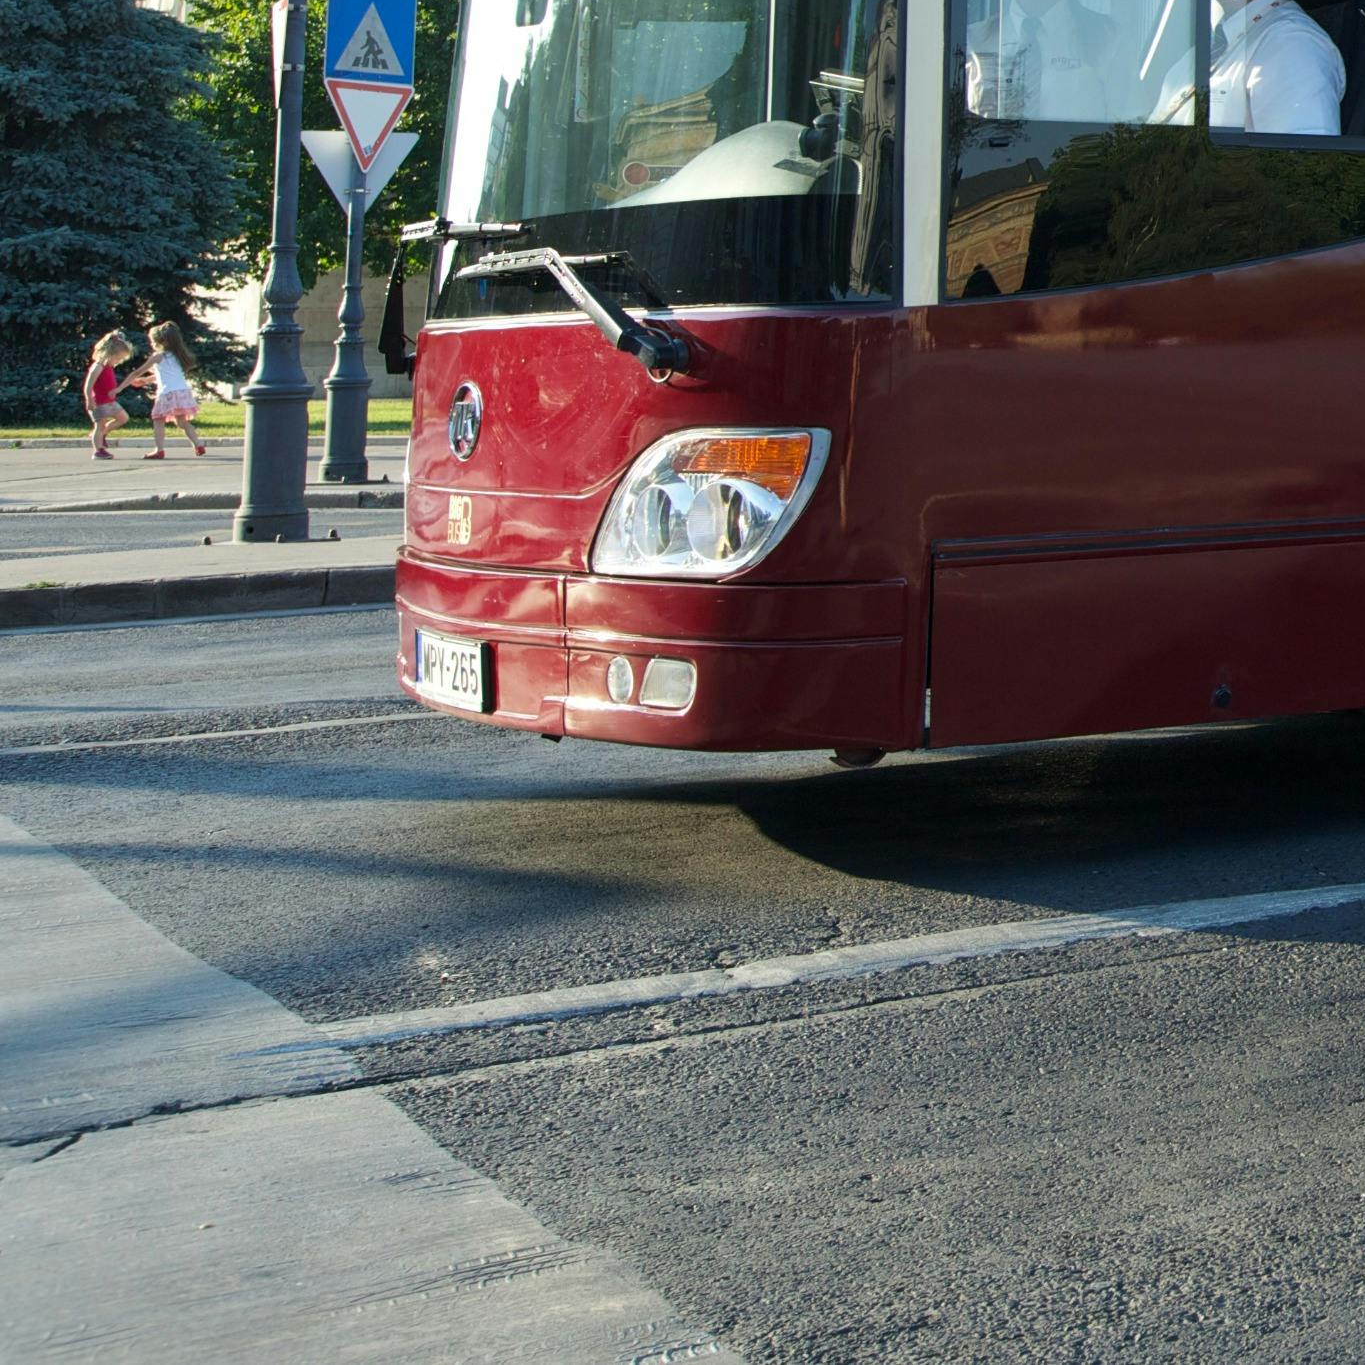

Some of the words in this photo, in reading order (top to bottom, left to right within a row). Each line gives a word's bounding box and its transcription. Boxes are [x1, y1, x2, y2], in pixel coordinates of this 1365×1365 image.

[448, 494, 461, 520] BIG
[447, 520, 460, 544] BUS
[423, 641, 479, 696] MPY-265
